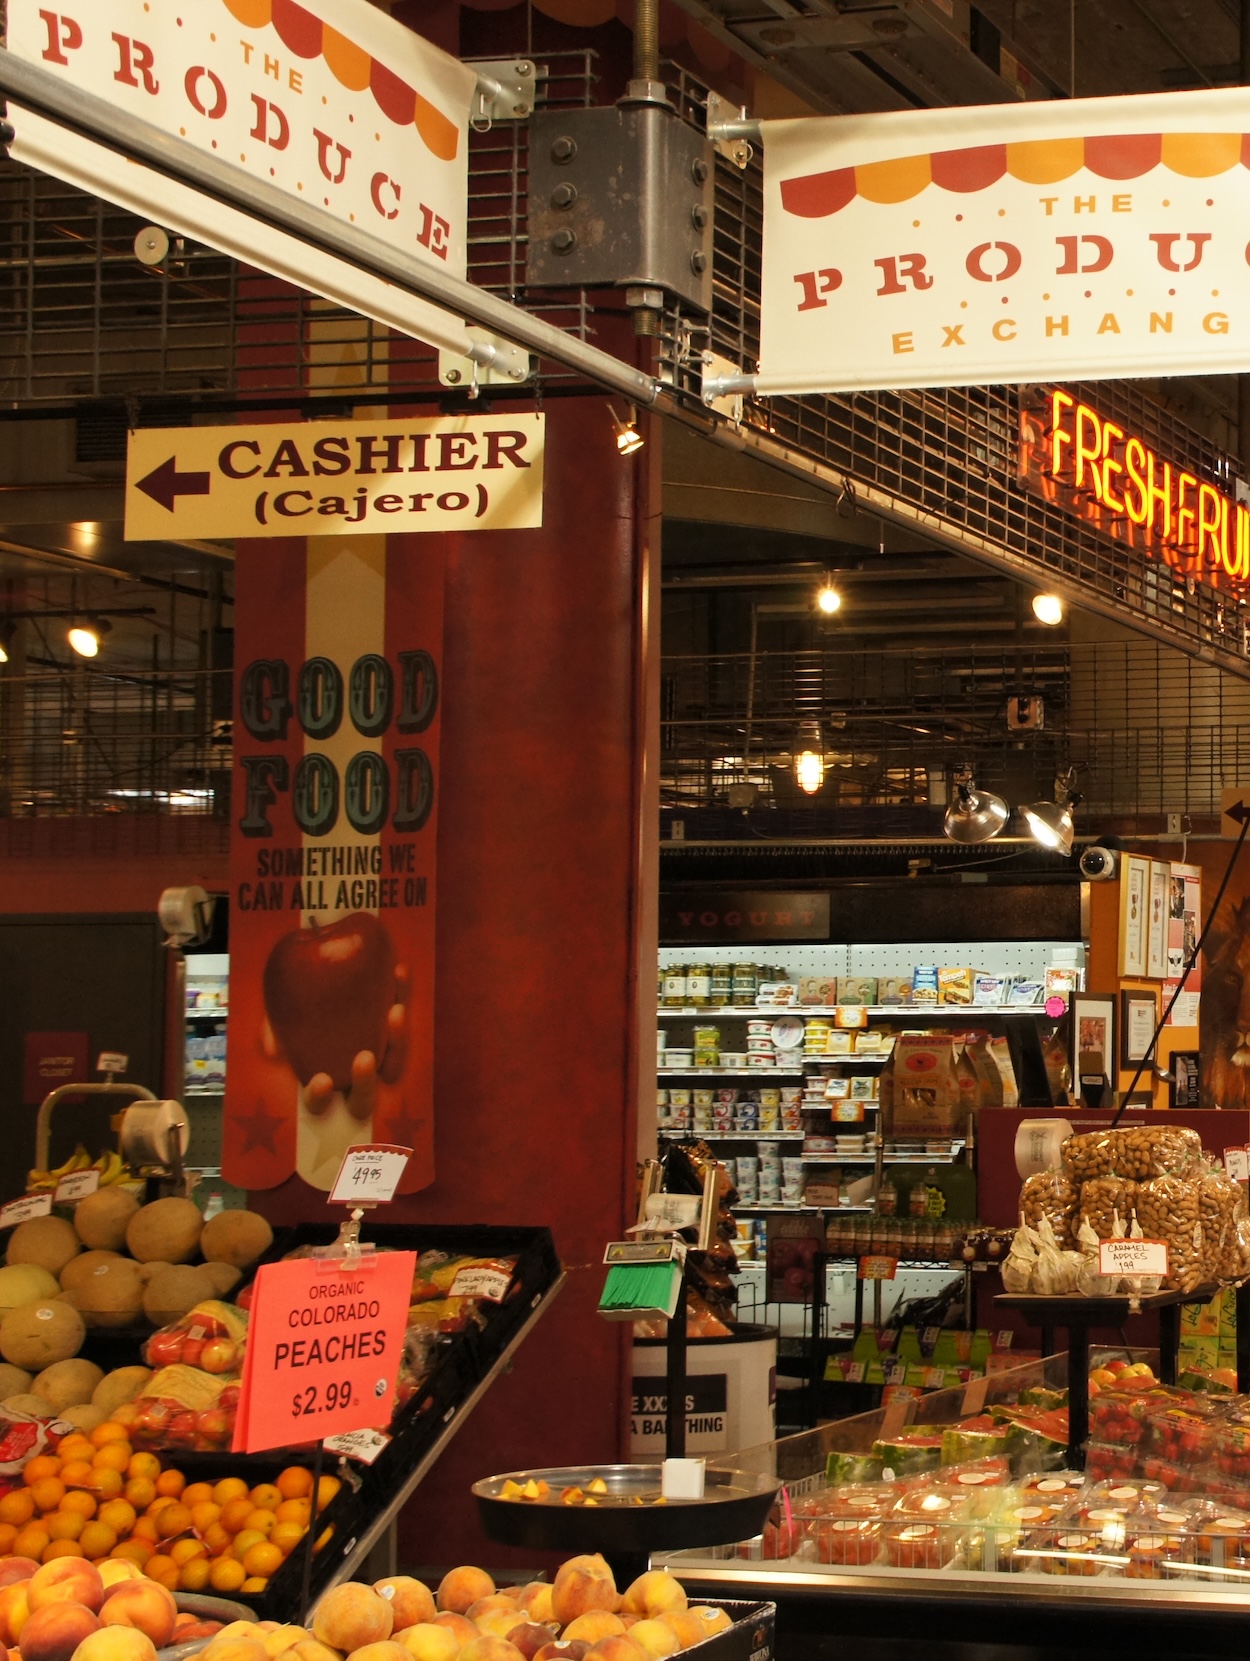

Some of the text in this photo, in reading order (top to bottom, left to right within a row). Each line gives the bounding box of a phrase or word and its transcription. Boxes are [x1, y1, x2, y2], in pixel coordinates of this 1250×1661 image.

[240, 40, 303, 95] THE
[39, 8, 451, 261] PRODUCE
[1038, 193, 1133, 216] THE
[217, 430, 531, 480] CASHIER
[1051, 390, 1170, 538] FRESH
[254, 483, 489, 525] (Cajero)
[240, 649, 439, 742] GOOD
[239, 748, 434, 838] FOOD
[257, 844, 416, 877] SOMETHING WE
[238, 877, 427, 911] CAN ALL AGREE ON
[678, 911, 816, 927] YOGURT
[780, 1219, 810, 1234] edible
[1107, 1244, 1150, 1253] CARAMEL
[1113, 1252, 1148, 1261] APPLES
[309, 1281, 365, 1300] ORGANIC
[288, 1300, 380, 1328] COLORADO
[274, 1330, 387, 1370] PEACHES
[291, 1381, 352, 1418] $2.99
[643, 1420, 667, 1435] BA
[685, 1416, 723, 1433] HING
